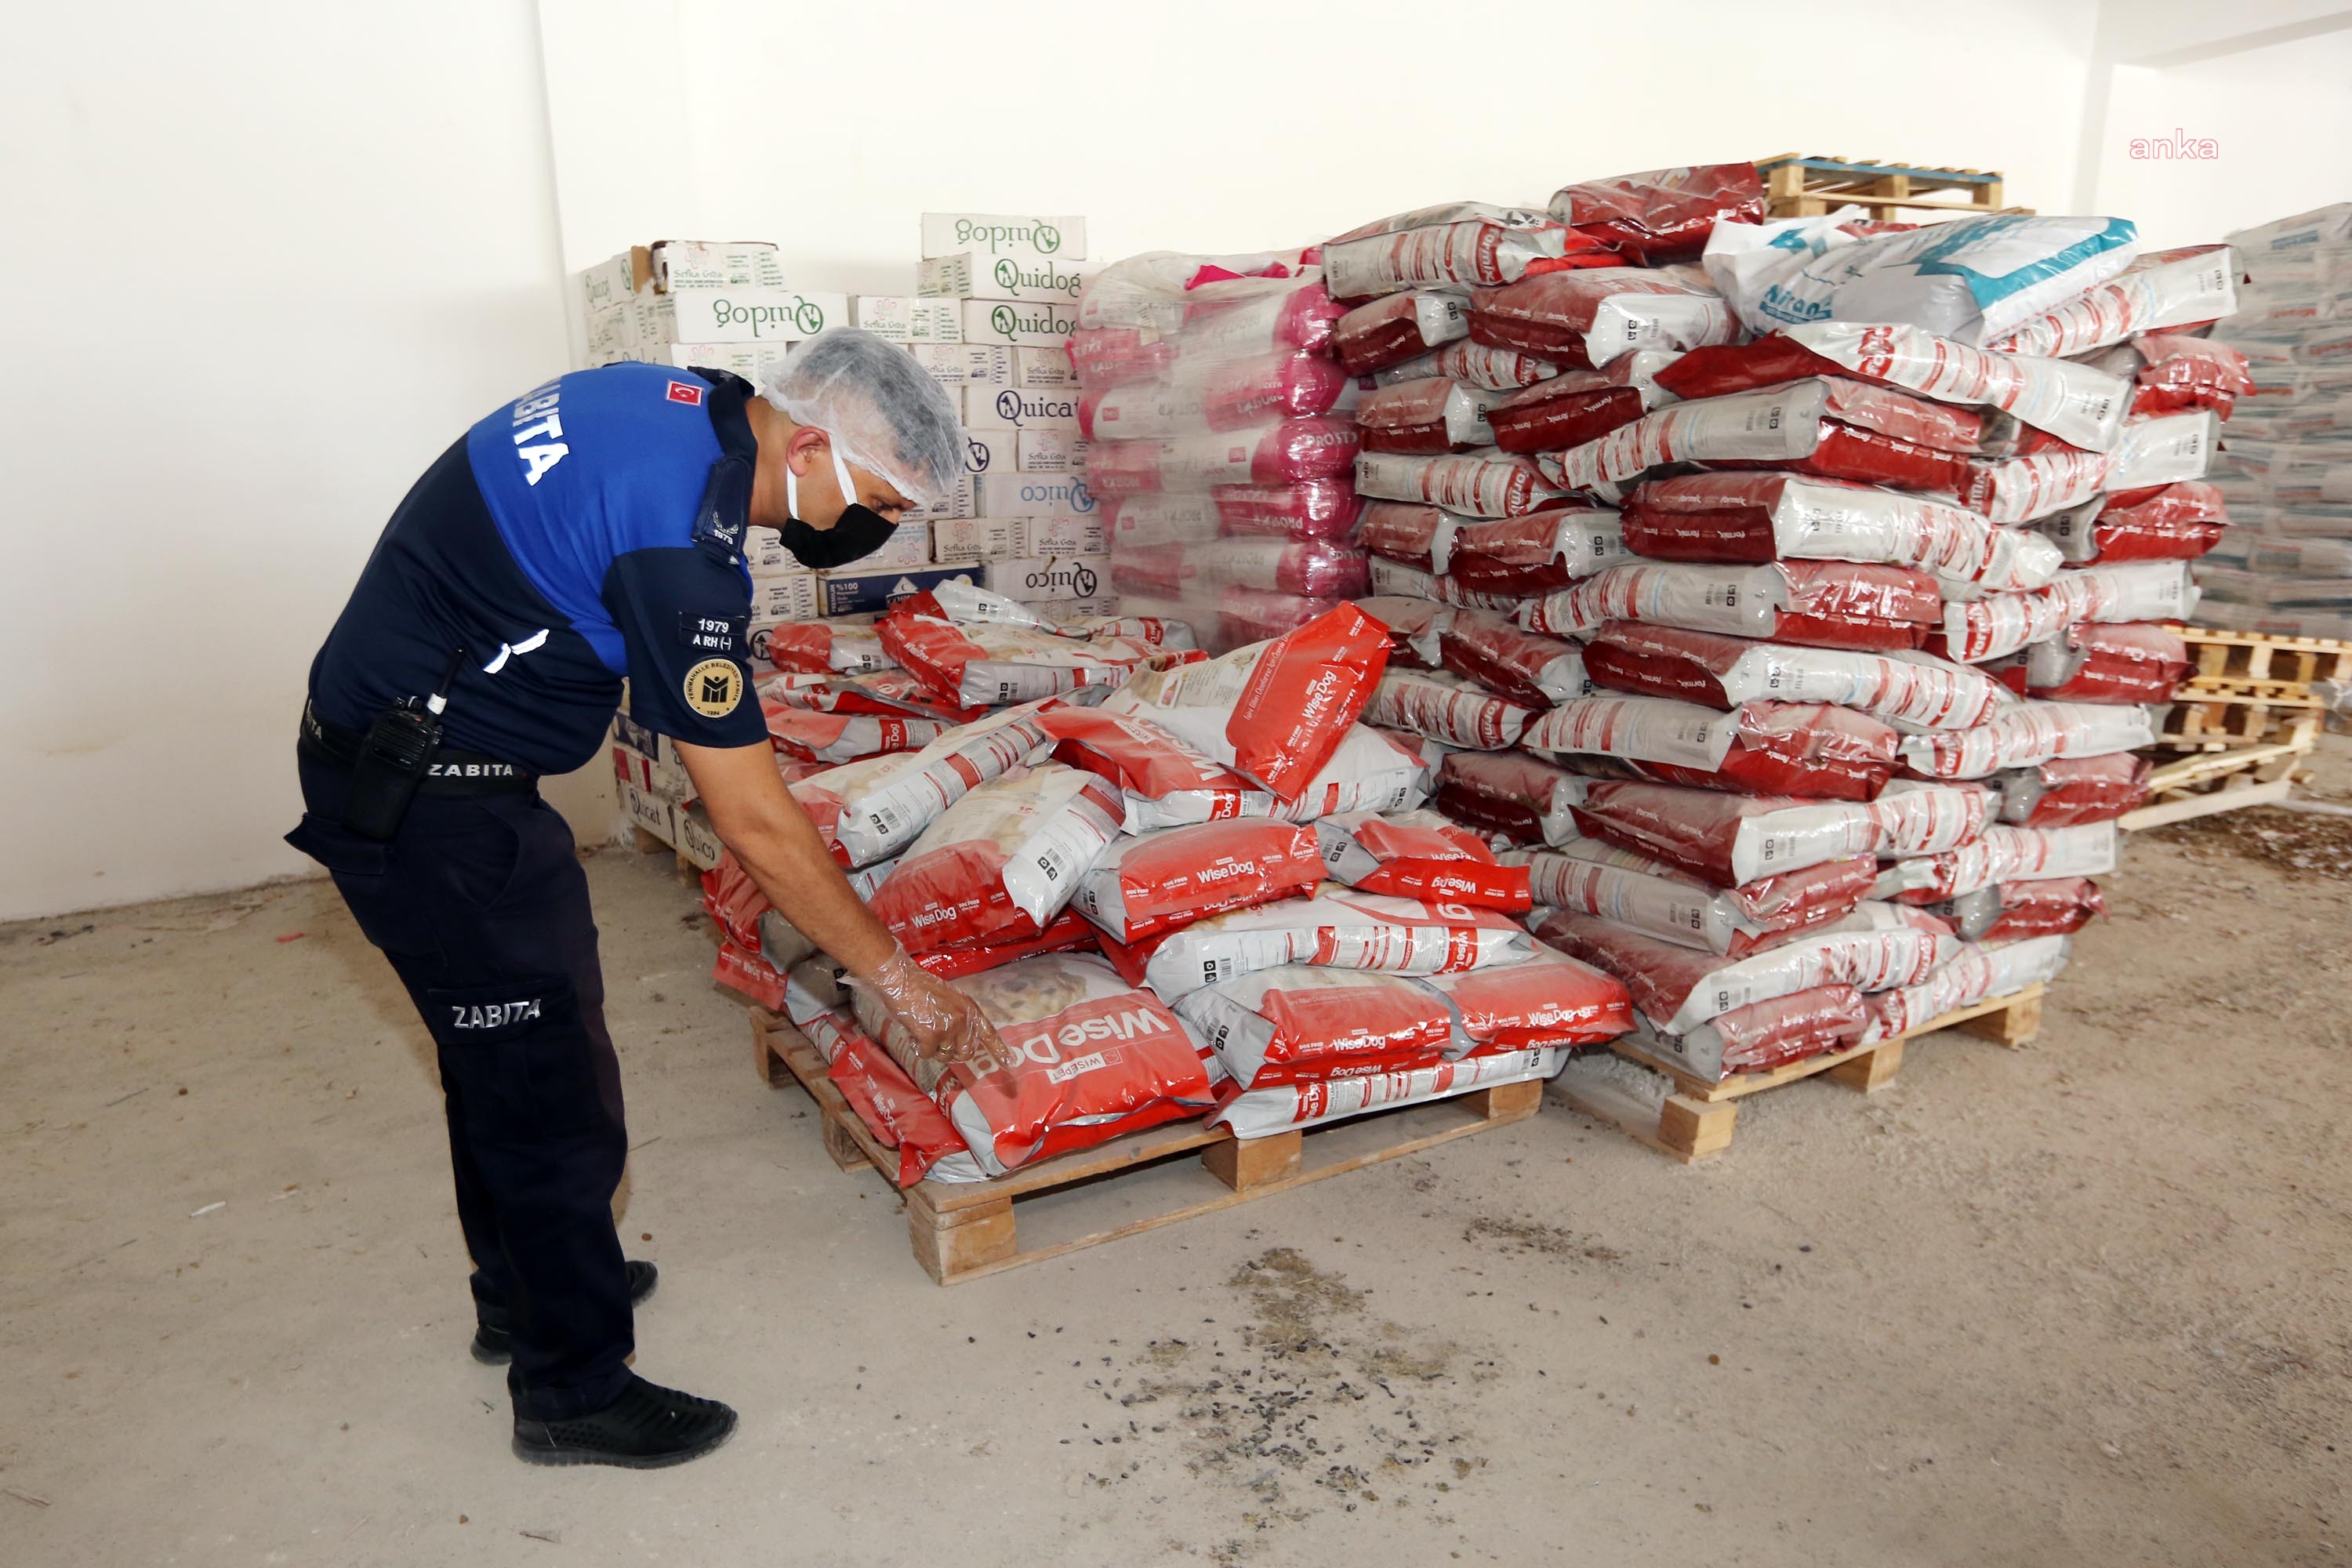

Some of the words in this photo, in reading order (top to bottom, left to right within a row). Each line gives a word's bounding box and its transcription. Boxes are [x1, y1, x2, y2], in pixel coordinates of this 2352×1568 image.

[955, 219, 1061, 253] Quidog
[1481, 229, 1498, 281] formix
[994, 258, 1082, 298] Quidog
[713, 295, 824, 338] Quidog
[1584, 396, 1612, 412] formix
[513, 377, 569, 487] BITA
[1021, 476, 1095, 513] Quico
[713, 529, 734, 546] 1979
[1717, 530, 1746, 539] formix
[836, 583, 858, 591] %100
[1025, 562, 1098, 597] Quico
[693, 634, 701, 645] A
[704, 636, 718, 648] RH
[698, 619, 729, 633] 1979
[1640, 673, 1661, 684] formix
[1677, 680, 1706, 688] formix
[428, 764, 514, 777] ZABITA
[630, 788, 661, 826] Quicat
[684, 818, 716, 861] Quico
[452, 999, 541, 1029] ZABITA
[1058, 1008, 1171, 1047] Wise
[1053, 1057, 1102, 1081] WISEPET
